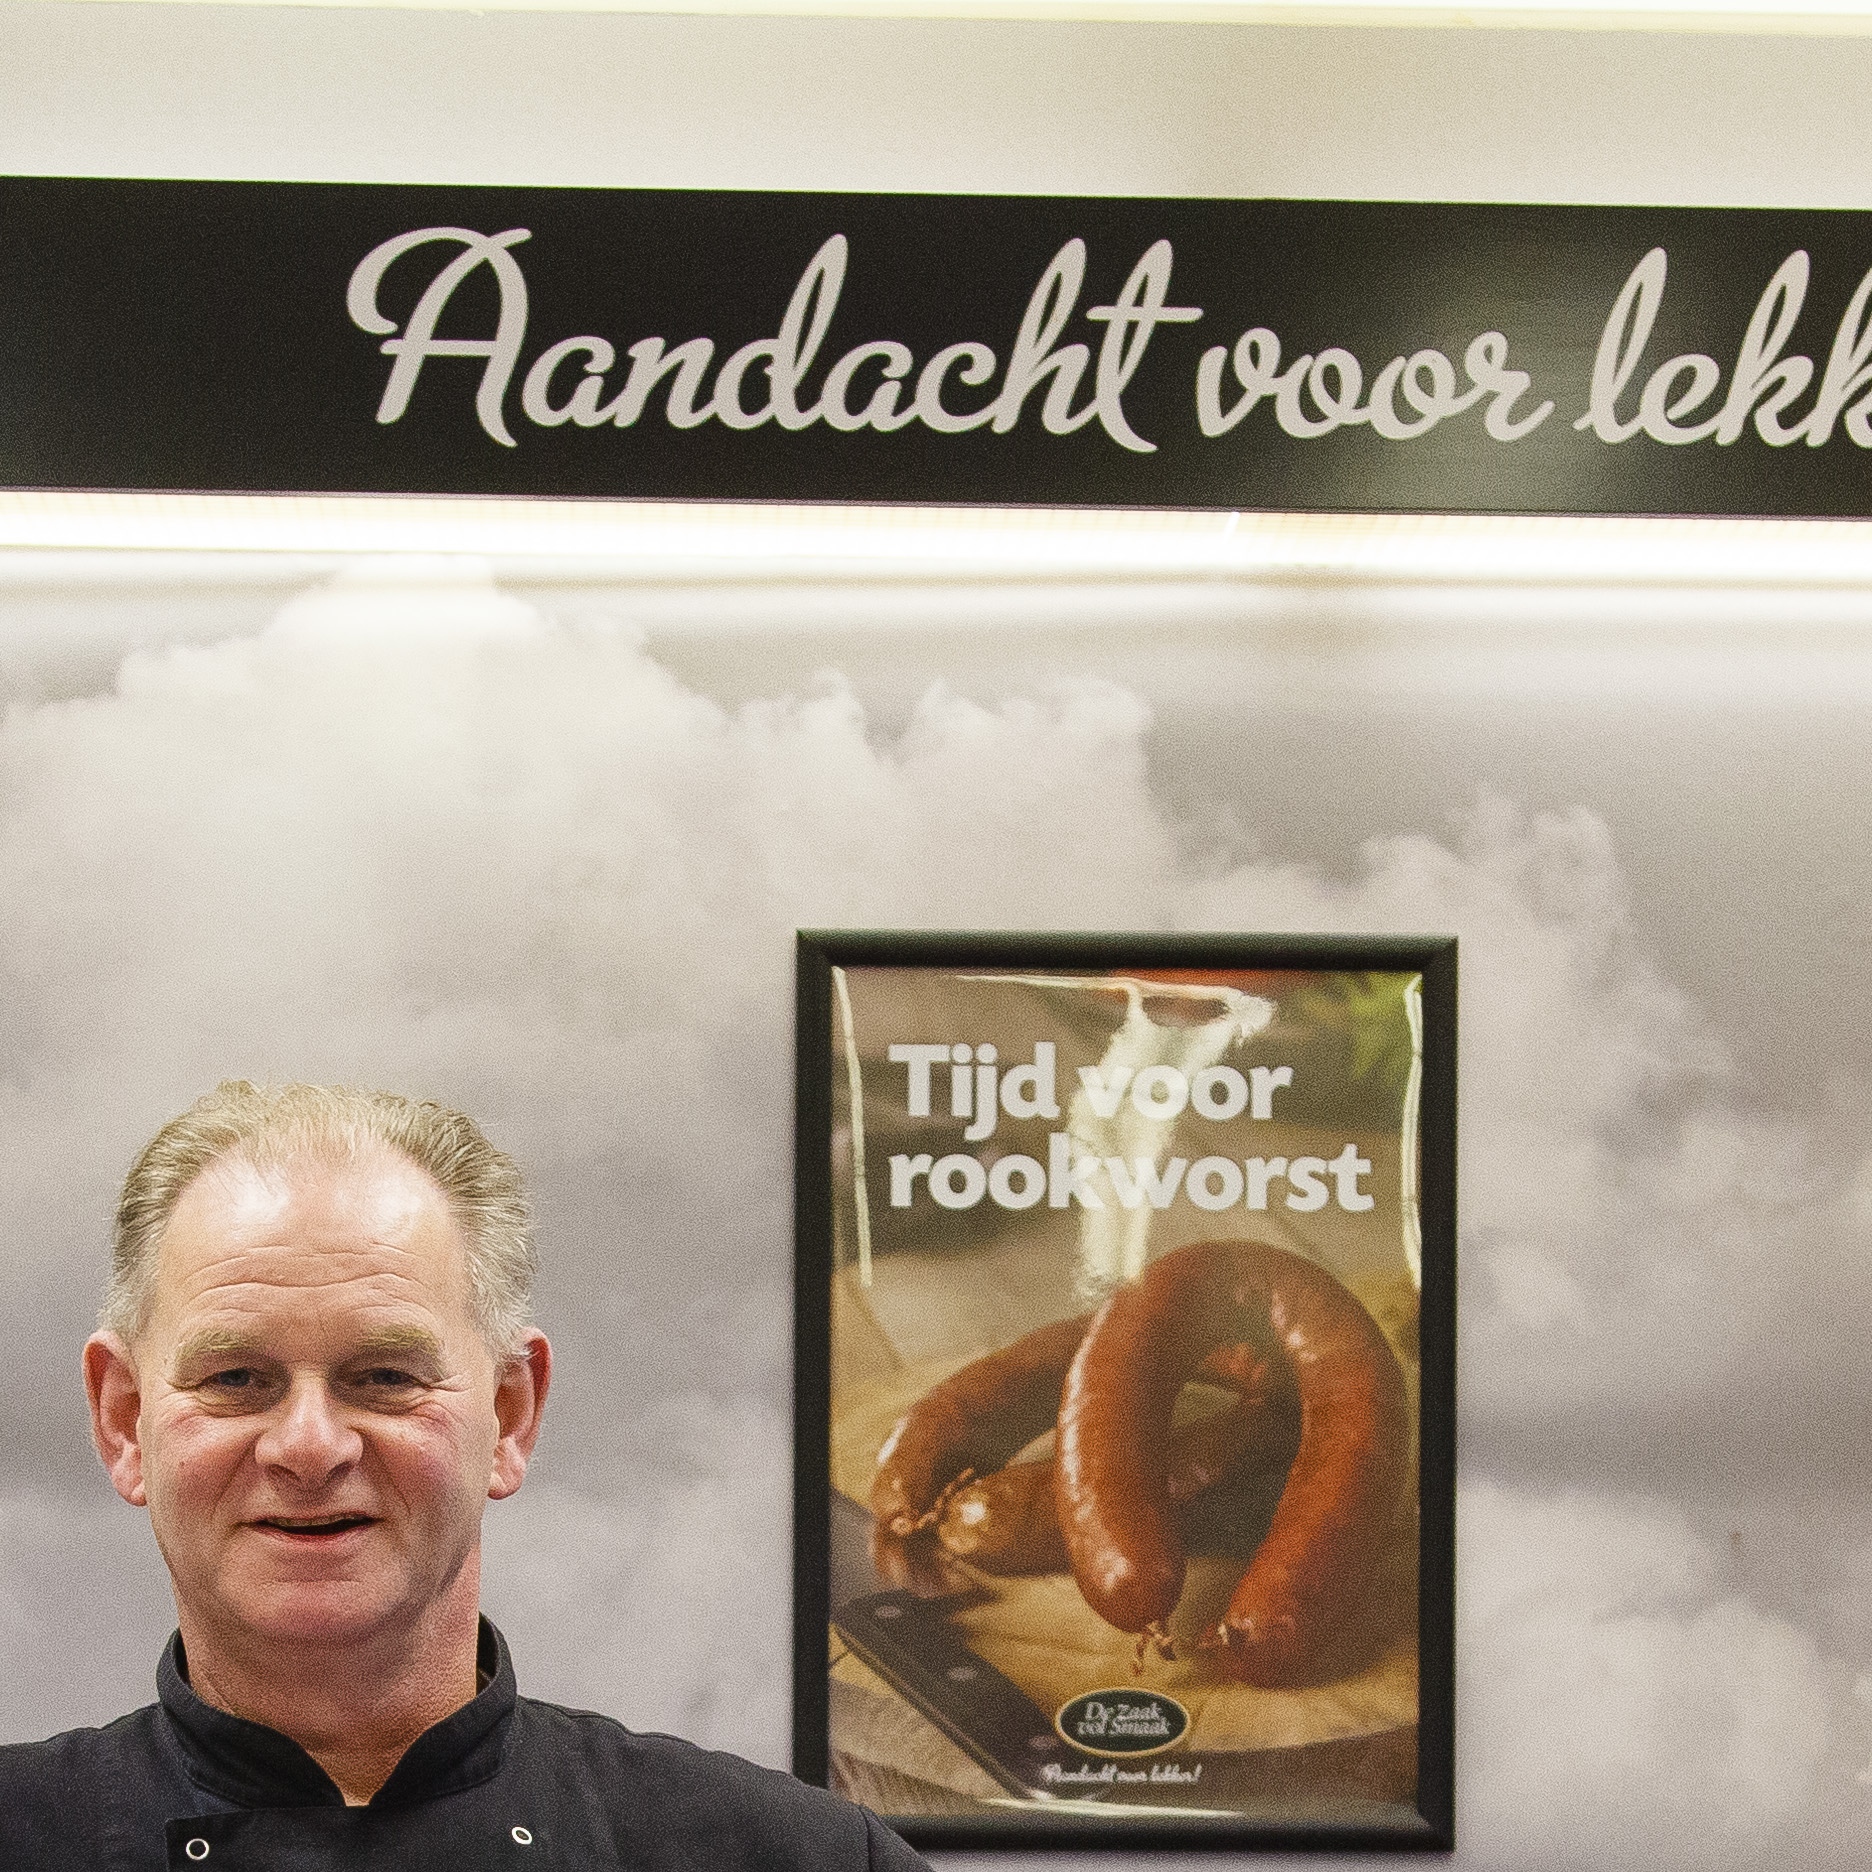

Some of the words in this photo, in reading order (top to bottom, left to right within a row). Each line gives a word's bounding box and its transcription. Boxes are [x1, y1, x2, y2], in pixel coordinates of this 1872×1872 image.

[347, 226, 1203, 453] Aandacht
[1195, 326, 1556, 444] voor
[888, 1042, 1059, 1140] Tijd
[1079, 1065, 1292, 1120] voor
[888, 1134, 1374, 1211] rookworst
